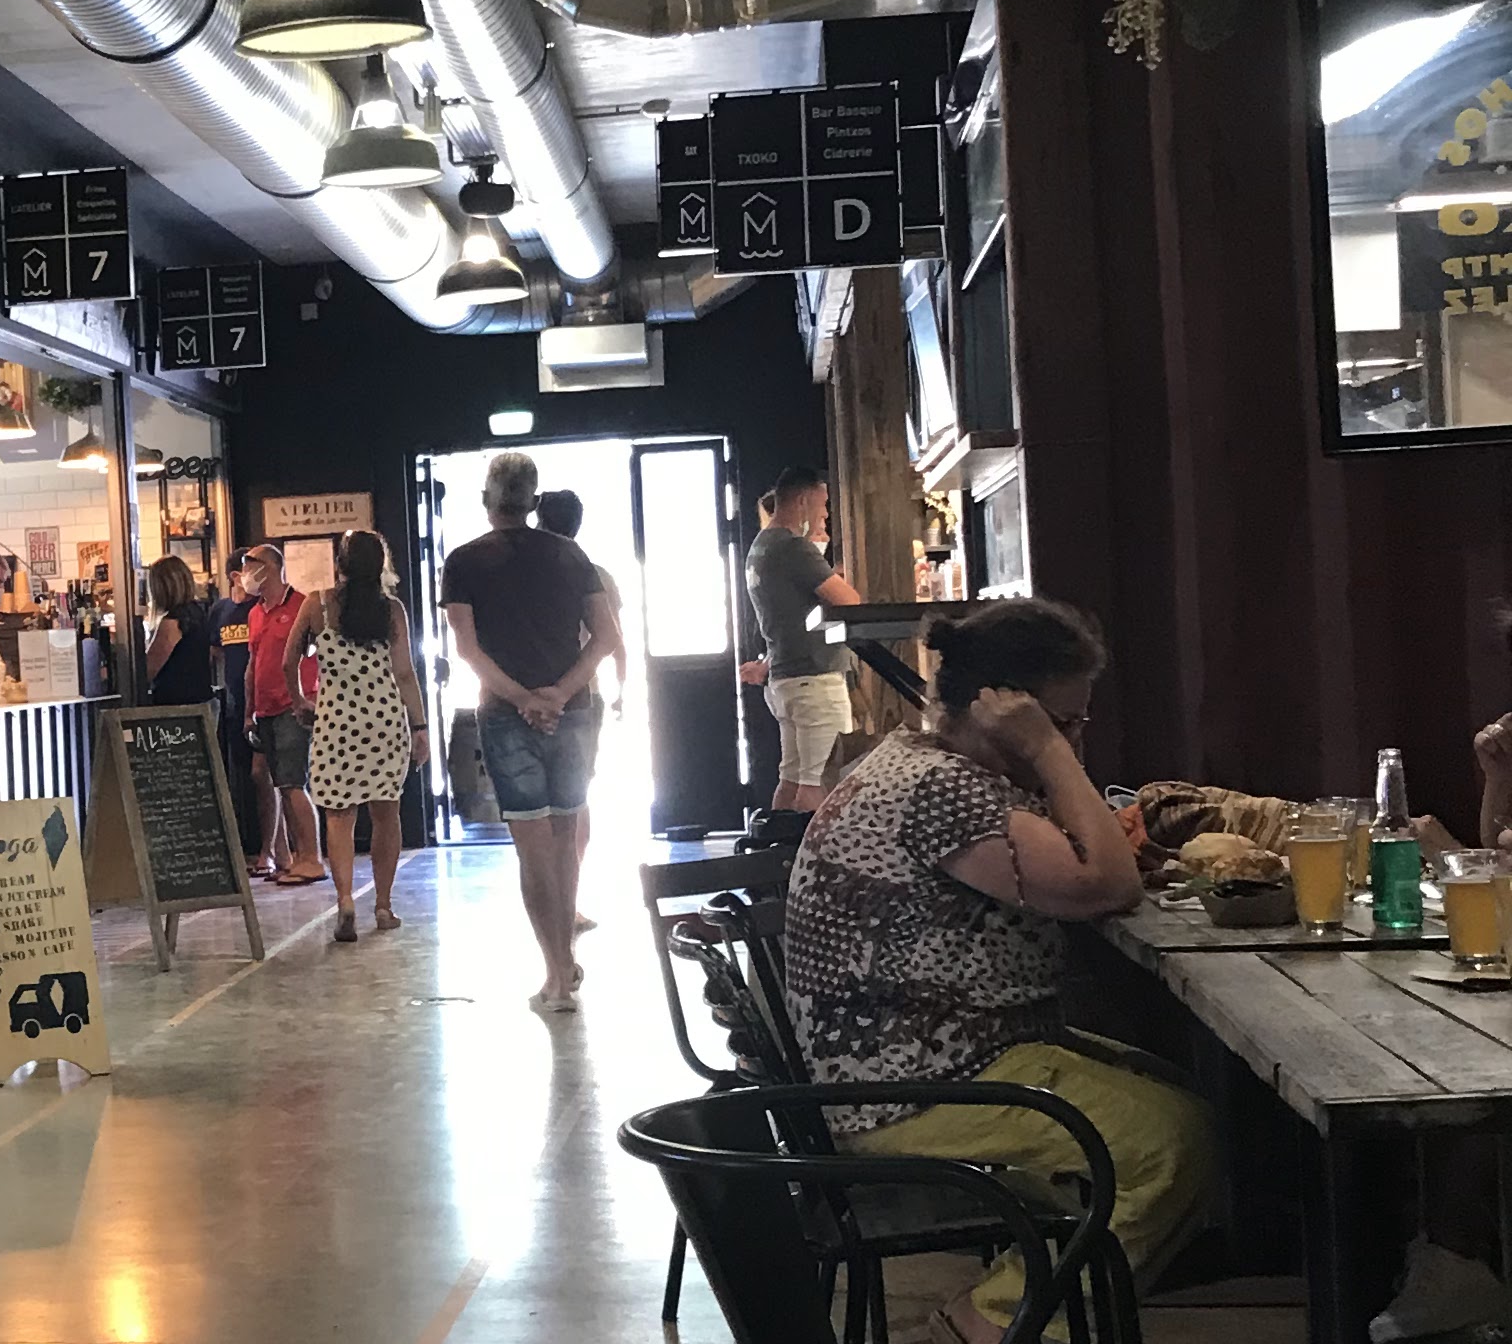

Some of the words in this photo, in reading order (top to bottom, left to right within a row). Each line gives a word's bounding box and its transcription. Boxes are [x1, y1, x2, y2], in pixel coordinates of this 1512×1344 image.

[811, 106, 833, 118] Bar
[836, 105, 882, 118] Basque
[826, 126, 872, 138] Pintxos
[737, 152, 778, 165] TXOKO
[823, 147, 873, 159] Cidrerie
[833, 198, 872, 241] D
[88, 250, 108, 282] 7
[229, 327, 246, 351] 7
[281, 502, 354, 516] ATELIER
[29, 543, 56, 560] BEER
[7, 891, 24, 902] ICE
[26, 886, 66, 900] CREAM
[3, 916, 44, 931] SHAKE
[43, 940, 75, 956] CAFE
